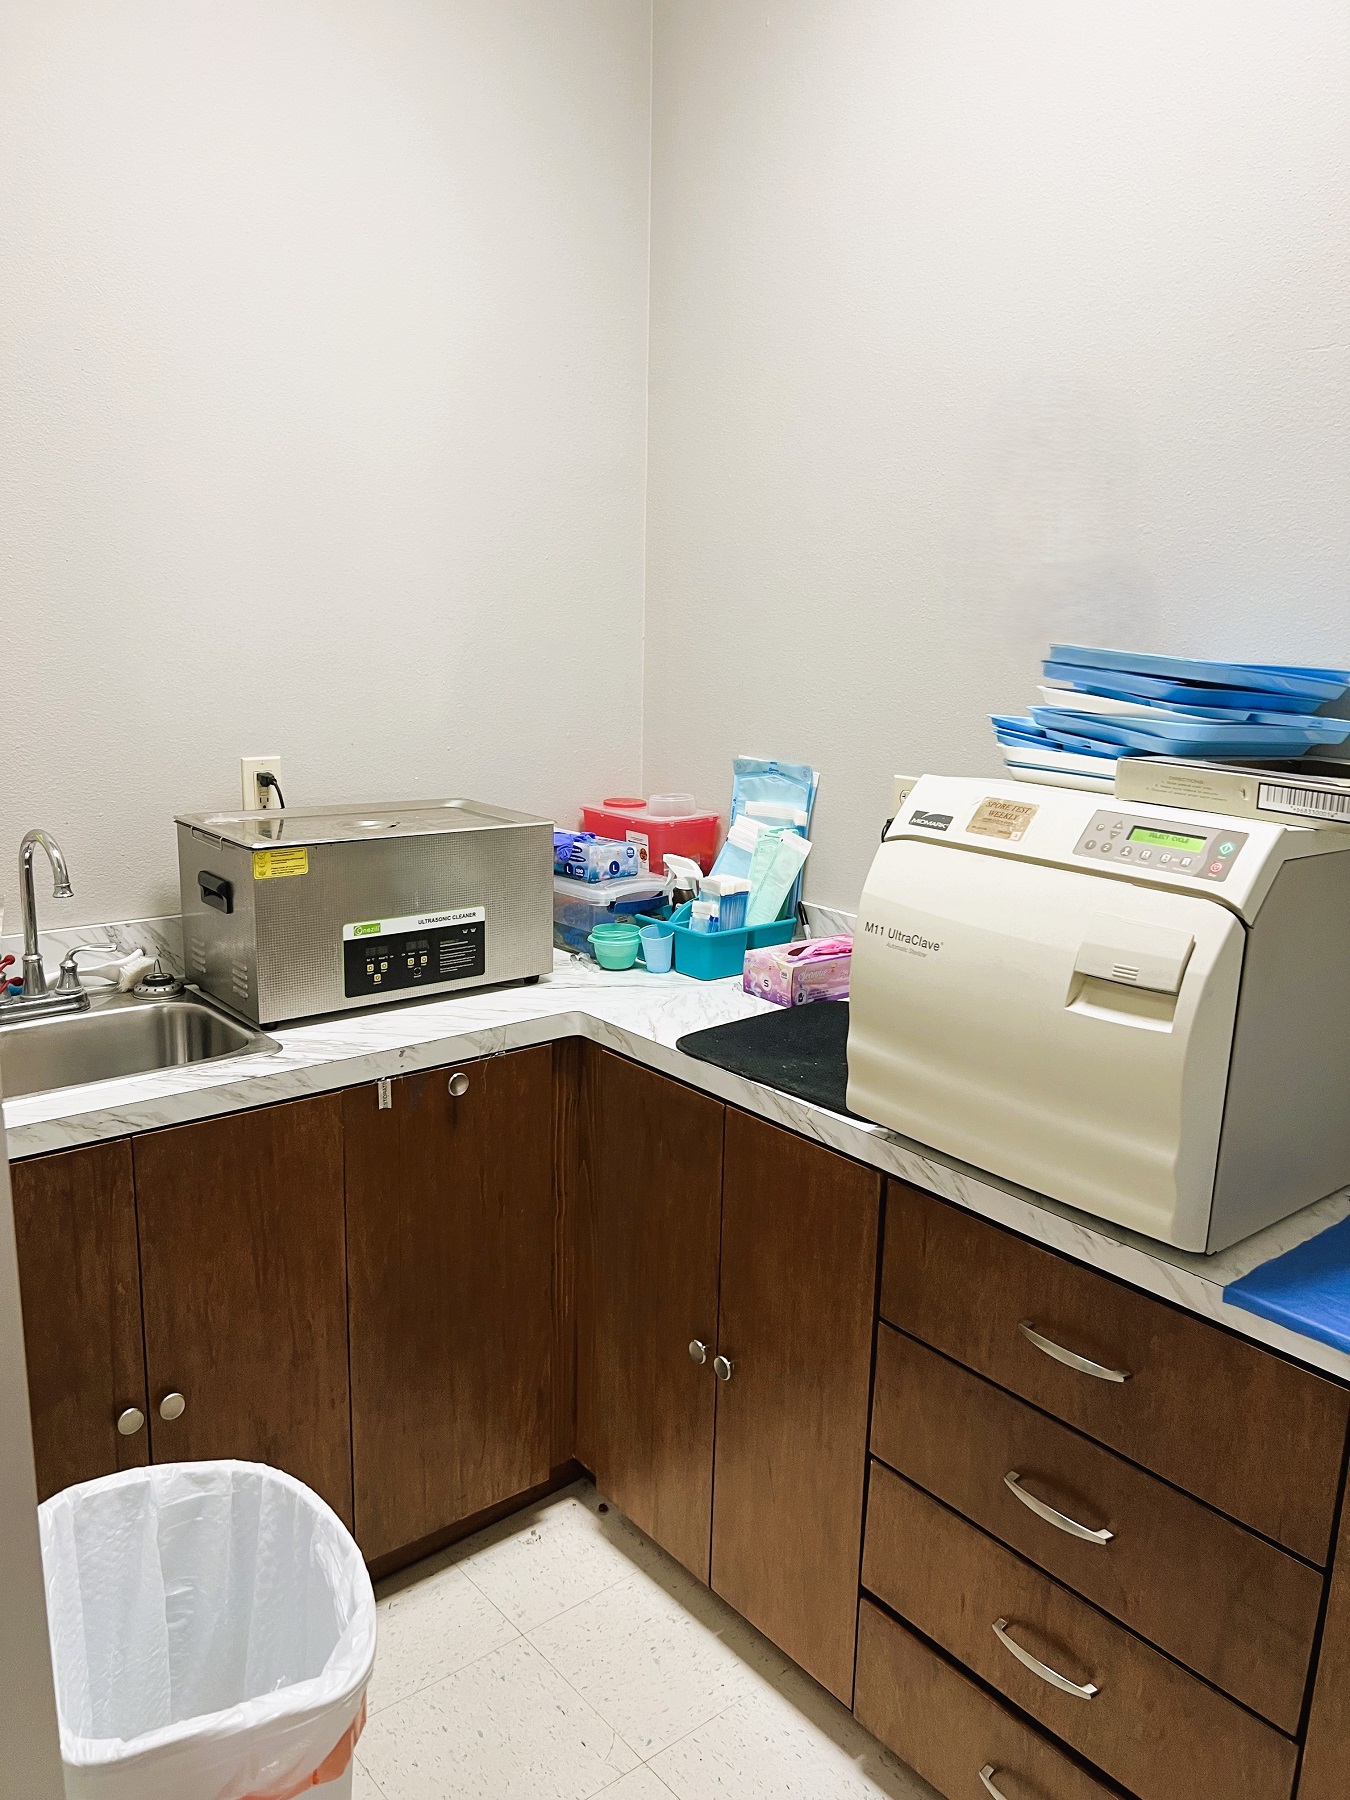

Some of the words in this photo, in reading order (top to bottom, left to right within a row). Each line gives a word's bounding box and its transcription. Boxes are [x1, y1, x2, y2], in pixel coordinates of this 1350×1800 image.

[985, 801, 1012, 811] SPORE
[1011, 805, 1032, 814] TEST
[988, 810, 1020, 821] WEEKLY
[910, 817, 950, 829] MIDMARK
[1171, 836, 1190, 844] CYCLE
[417, 915, 451, 925] ULTRASONIC
[451, 911, 477, 921] CLEANER
[864, 921, 885, 936] M11
